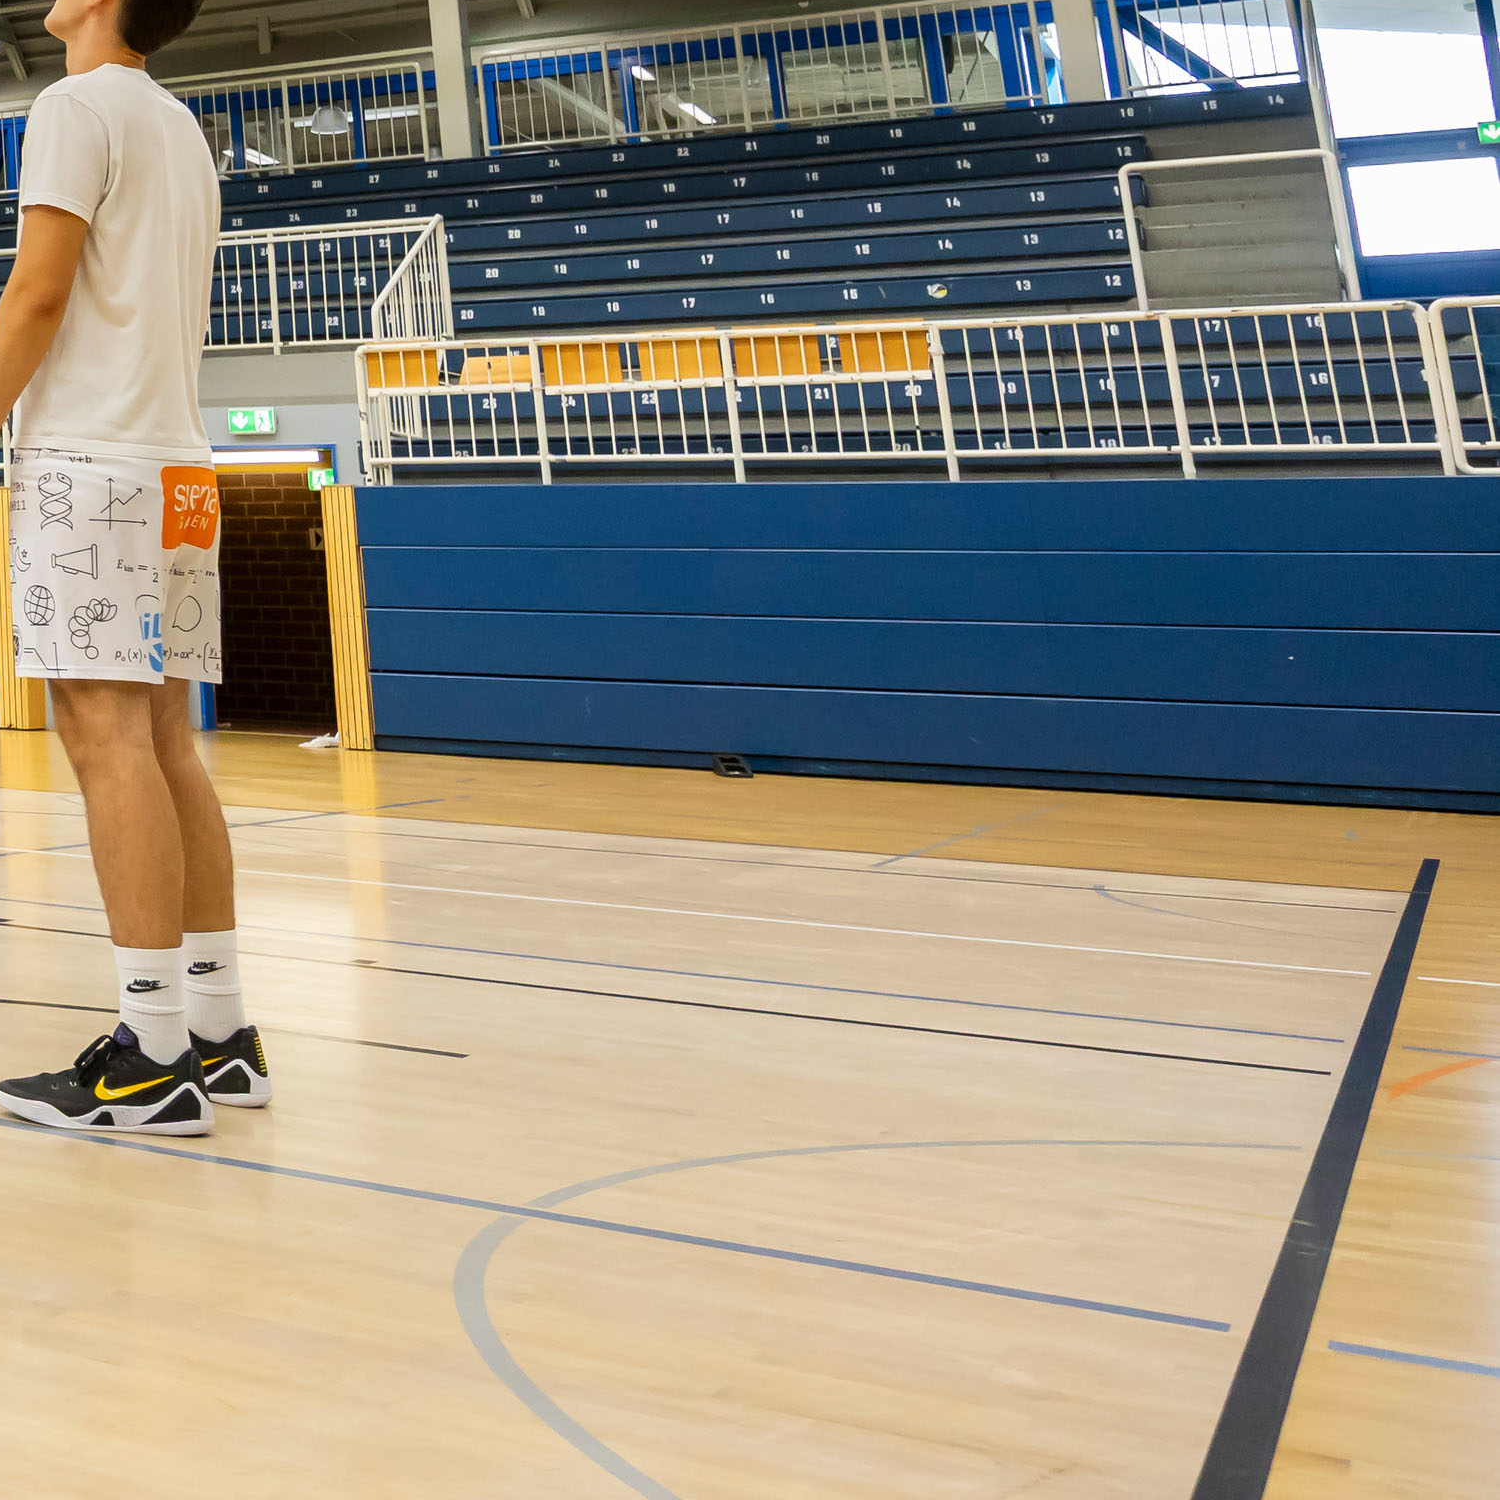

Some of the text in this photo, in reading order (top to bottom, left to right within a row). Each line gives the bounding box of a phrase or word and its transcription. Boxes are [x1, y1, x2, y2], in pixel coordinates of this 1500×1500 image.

[1108, 229, 1123, 240] 12
[1204, 320, 1221, 332] 17
[1309, 372, 1328, 385] 16
[815, 388, 829, 400] 21
[173, 484, 217, 514] siena
[192, 960, 217, 971] NIKE
[132, 978, 161, 989] NIKE
